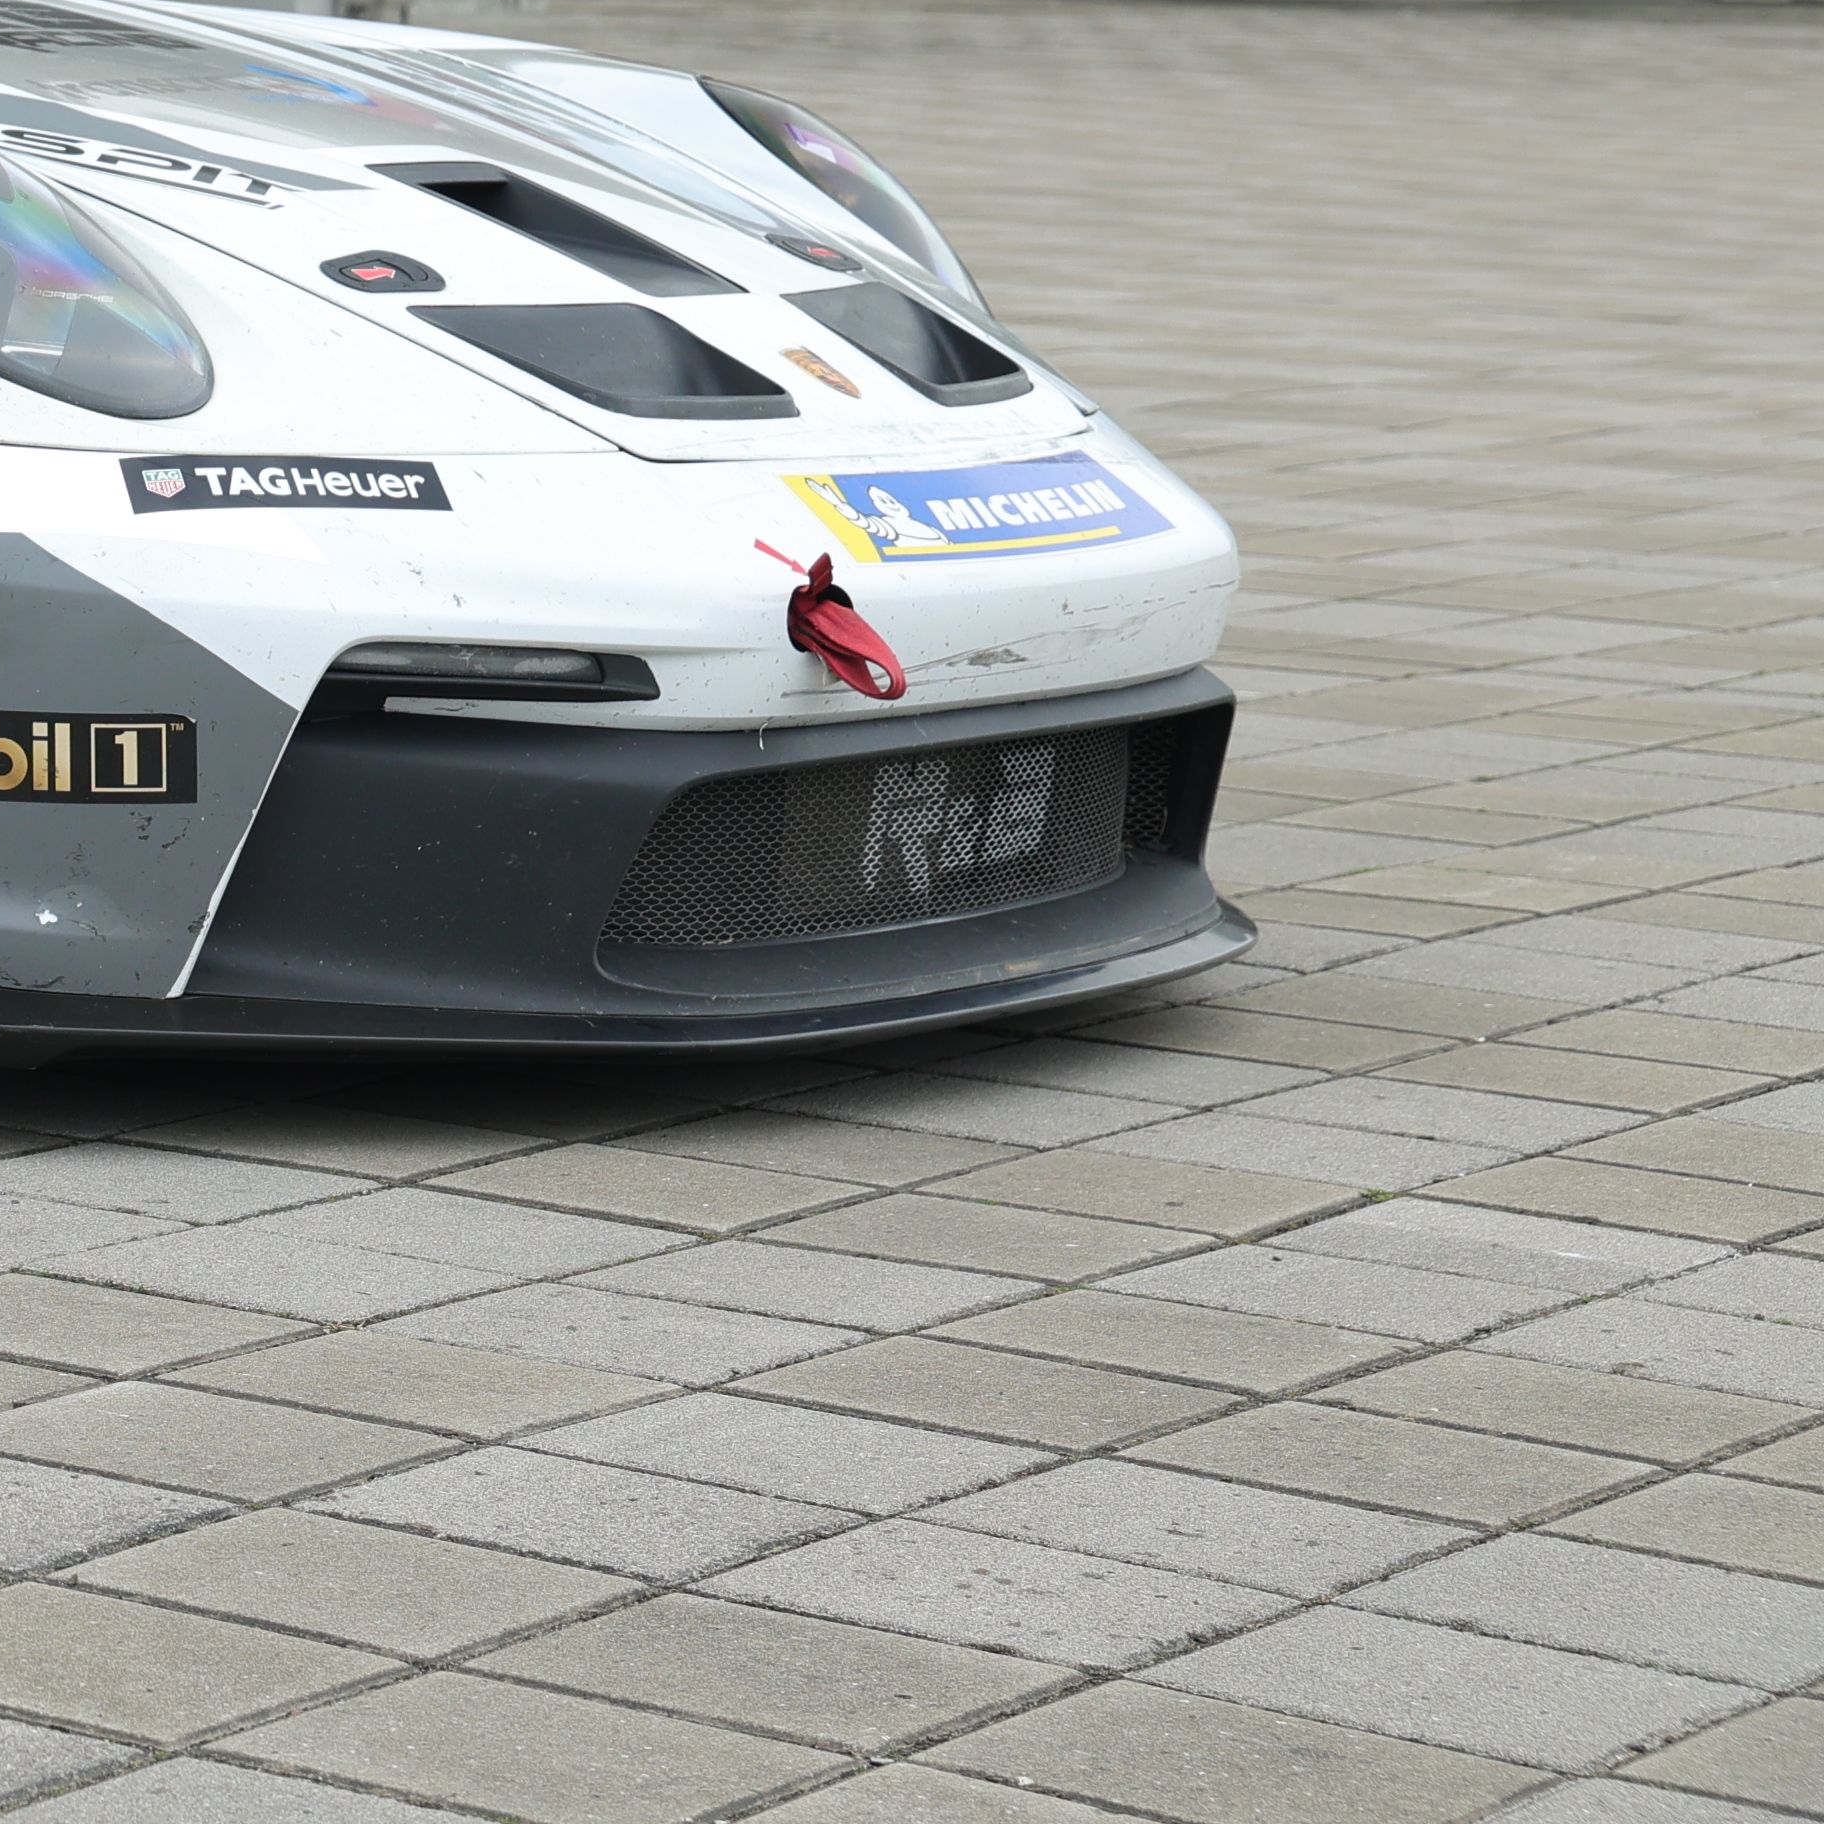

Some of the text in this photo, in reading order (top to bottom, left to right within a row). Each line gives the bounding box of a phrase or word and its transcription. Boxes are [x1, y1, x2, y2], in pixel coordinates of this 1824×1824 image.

[147, 471, 179, 481] TAG
[925, 479, 1127, 531] MICHELIN
[114, 730, 139, 786] 1
